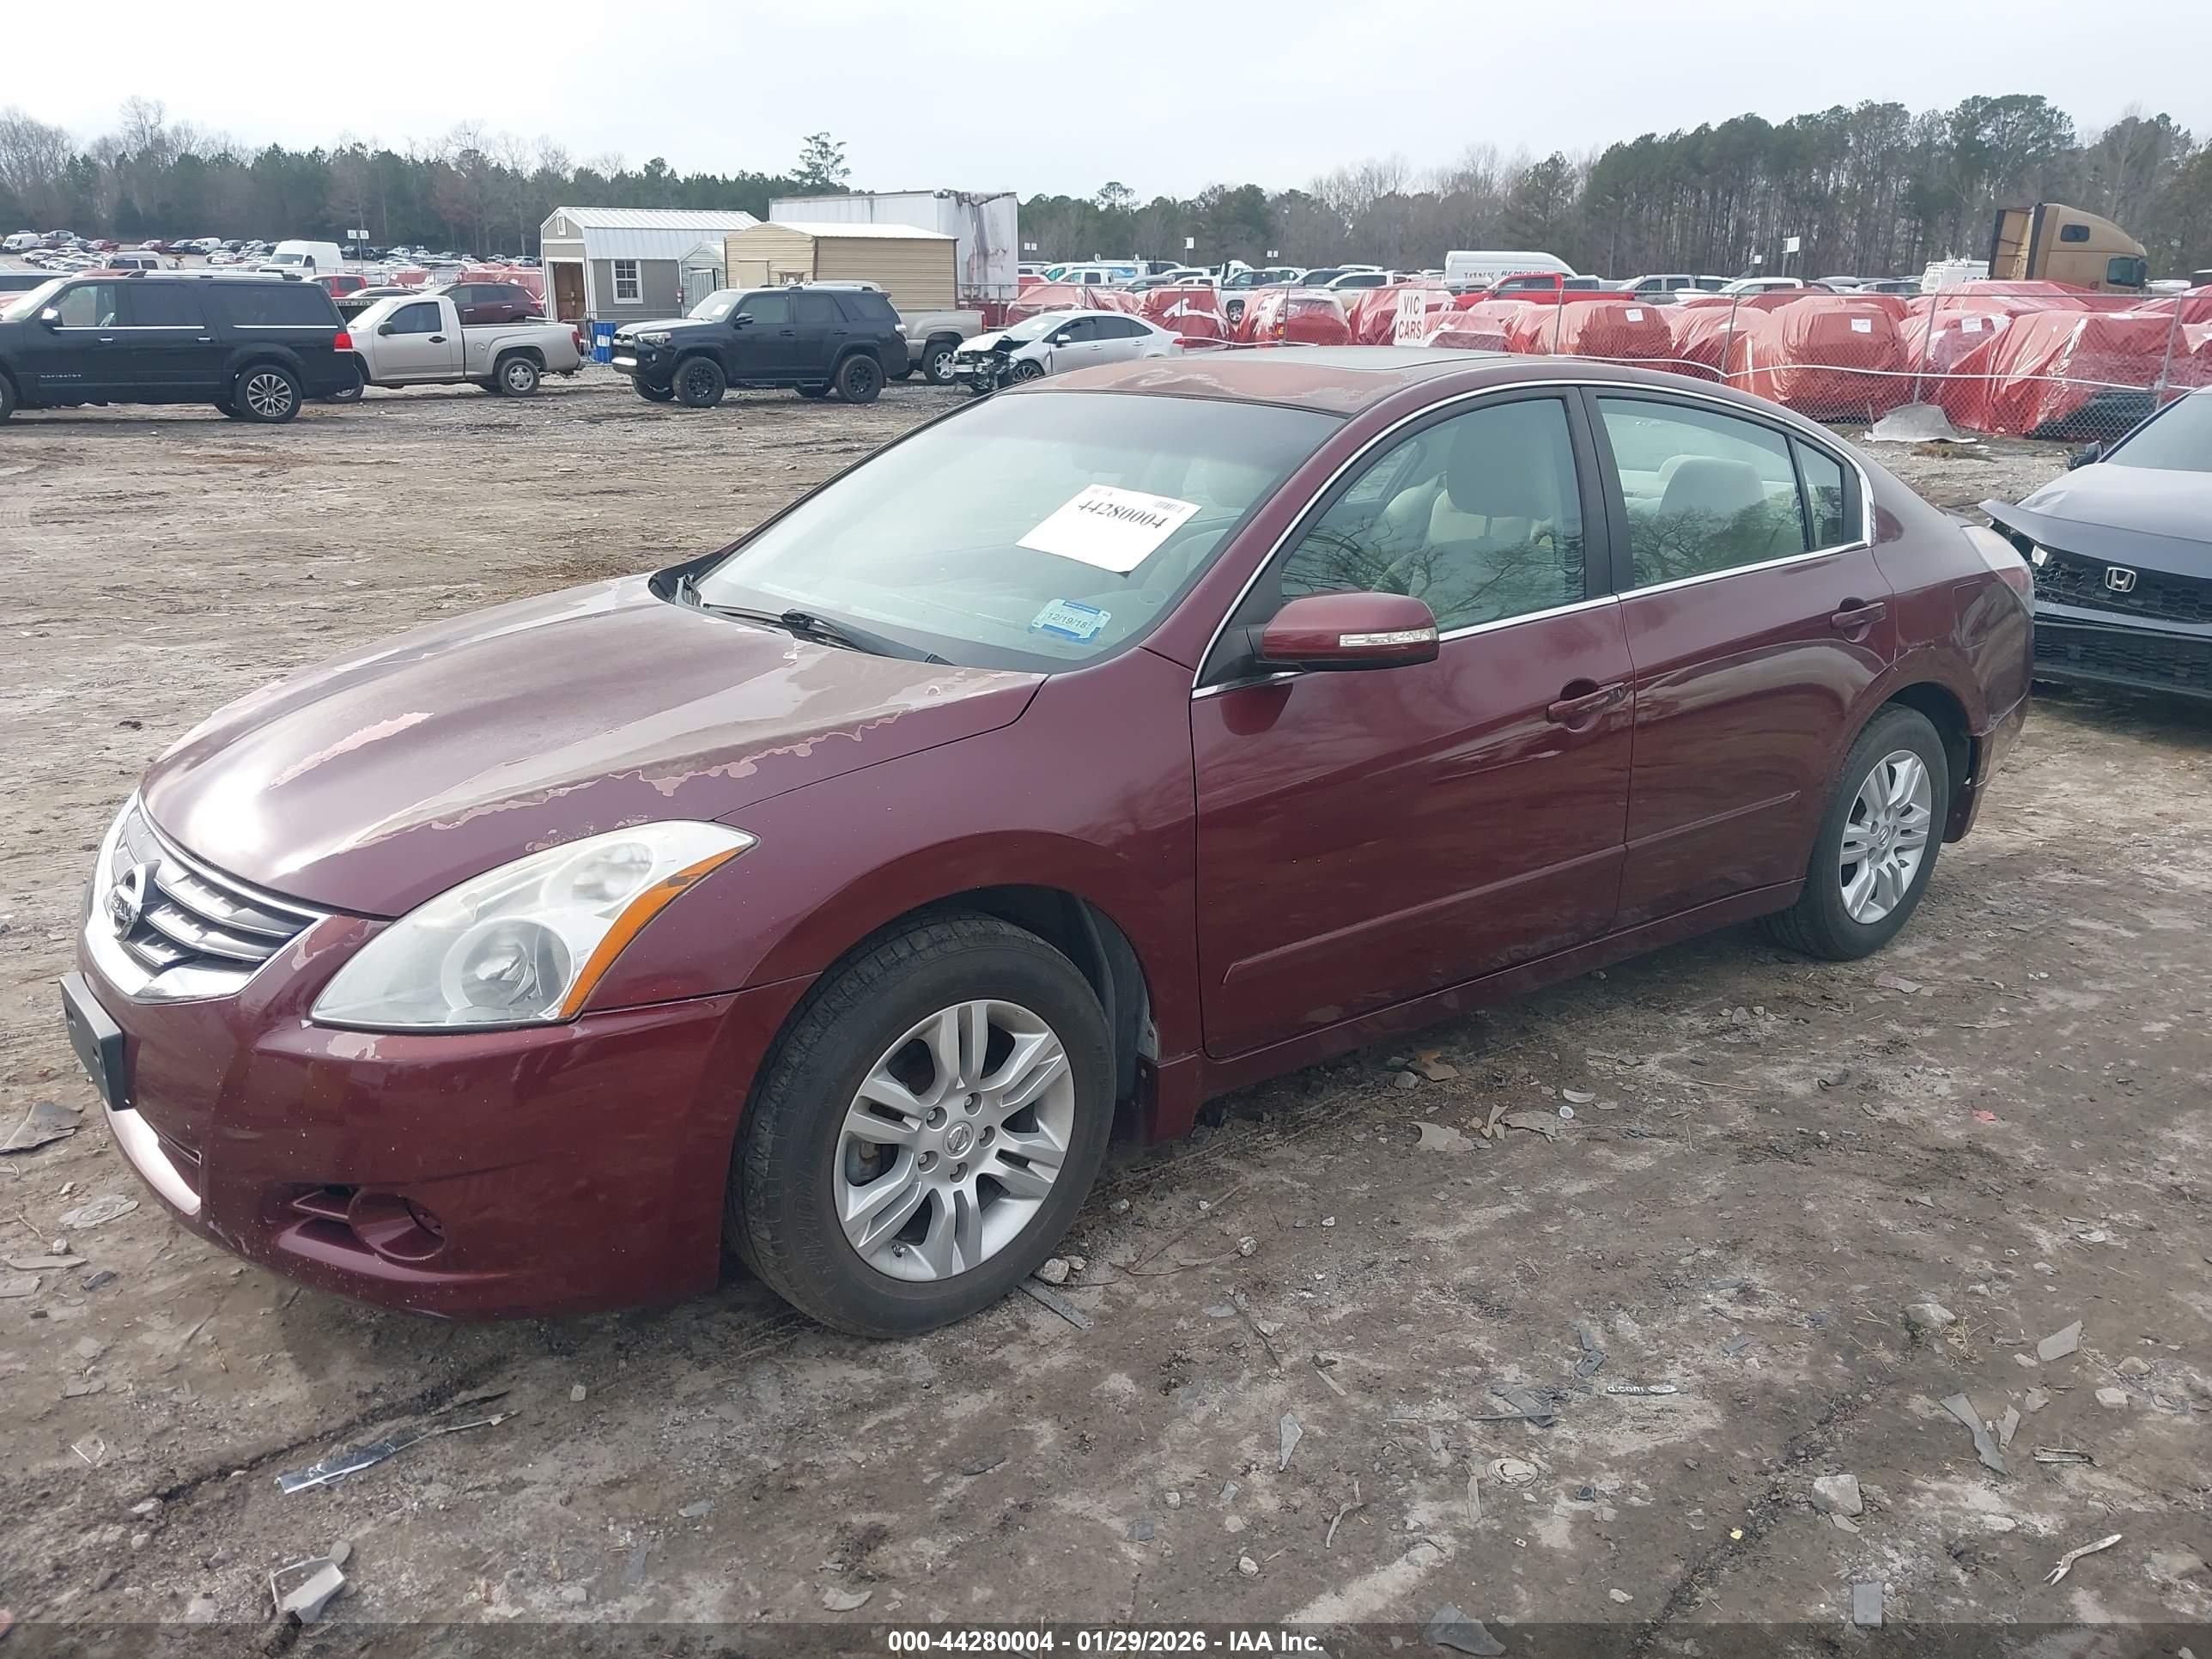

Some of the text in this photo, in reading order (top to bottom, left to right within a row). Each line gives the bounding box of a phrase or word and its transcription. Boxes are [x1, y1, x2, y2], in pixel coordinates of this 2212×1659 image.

[1404, 295, 1420, 315] VIC
[1398, 320, 1422, 340] CARS
[1079, 500, 1169, 529] 44280004
